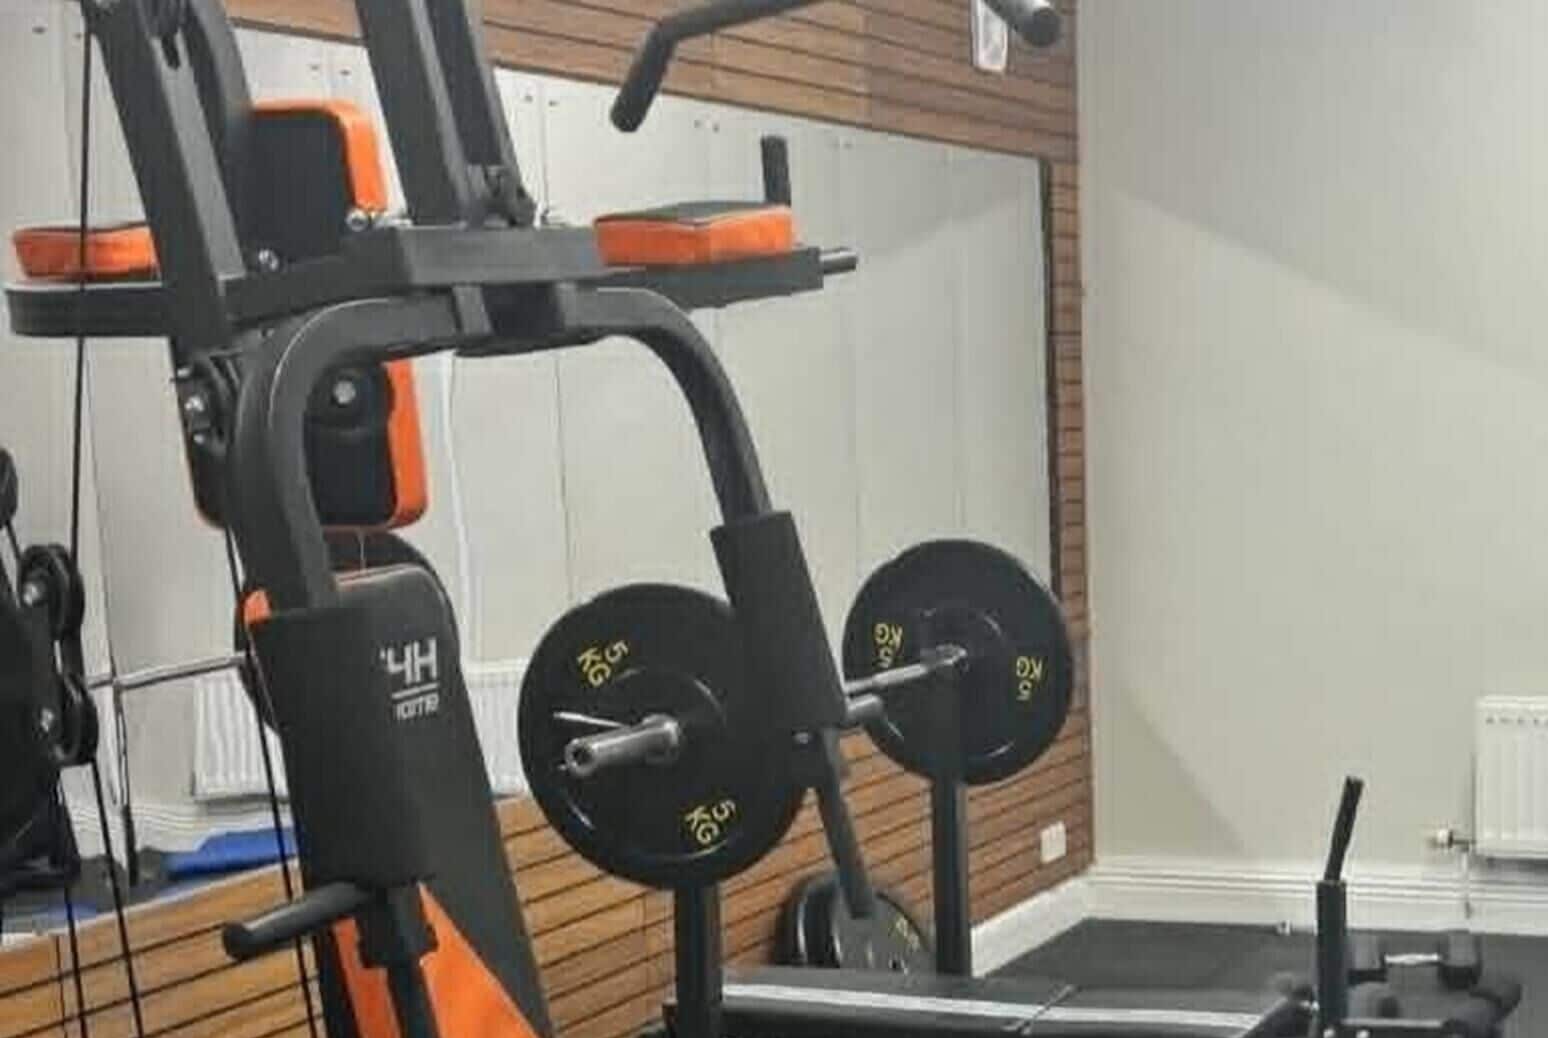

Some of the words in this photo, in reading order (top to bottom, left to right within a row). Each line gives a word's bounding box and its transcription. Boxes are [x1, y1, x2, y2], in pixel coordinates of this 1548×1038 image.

[605, 640, 629, 663] 5
[577, 646, 611, 687] KG
[1016, 655, 1043, 681] KG
[712, 800, 736, 819] 5
[685, 806, 721, 845] KG
